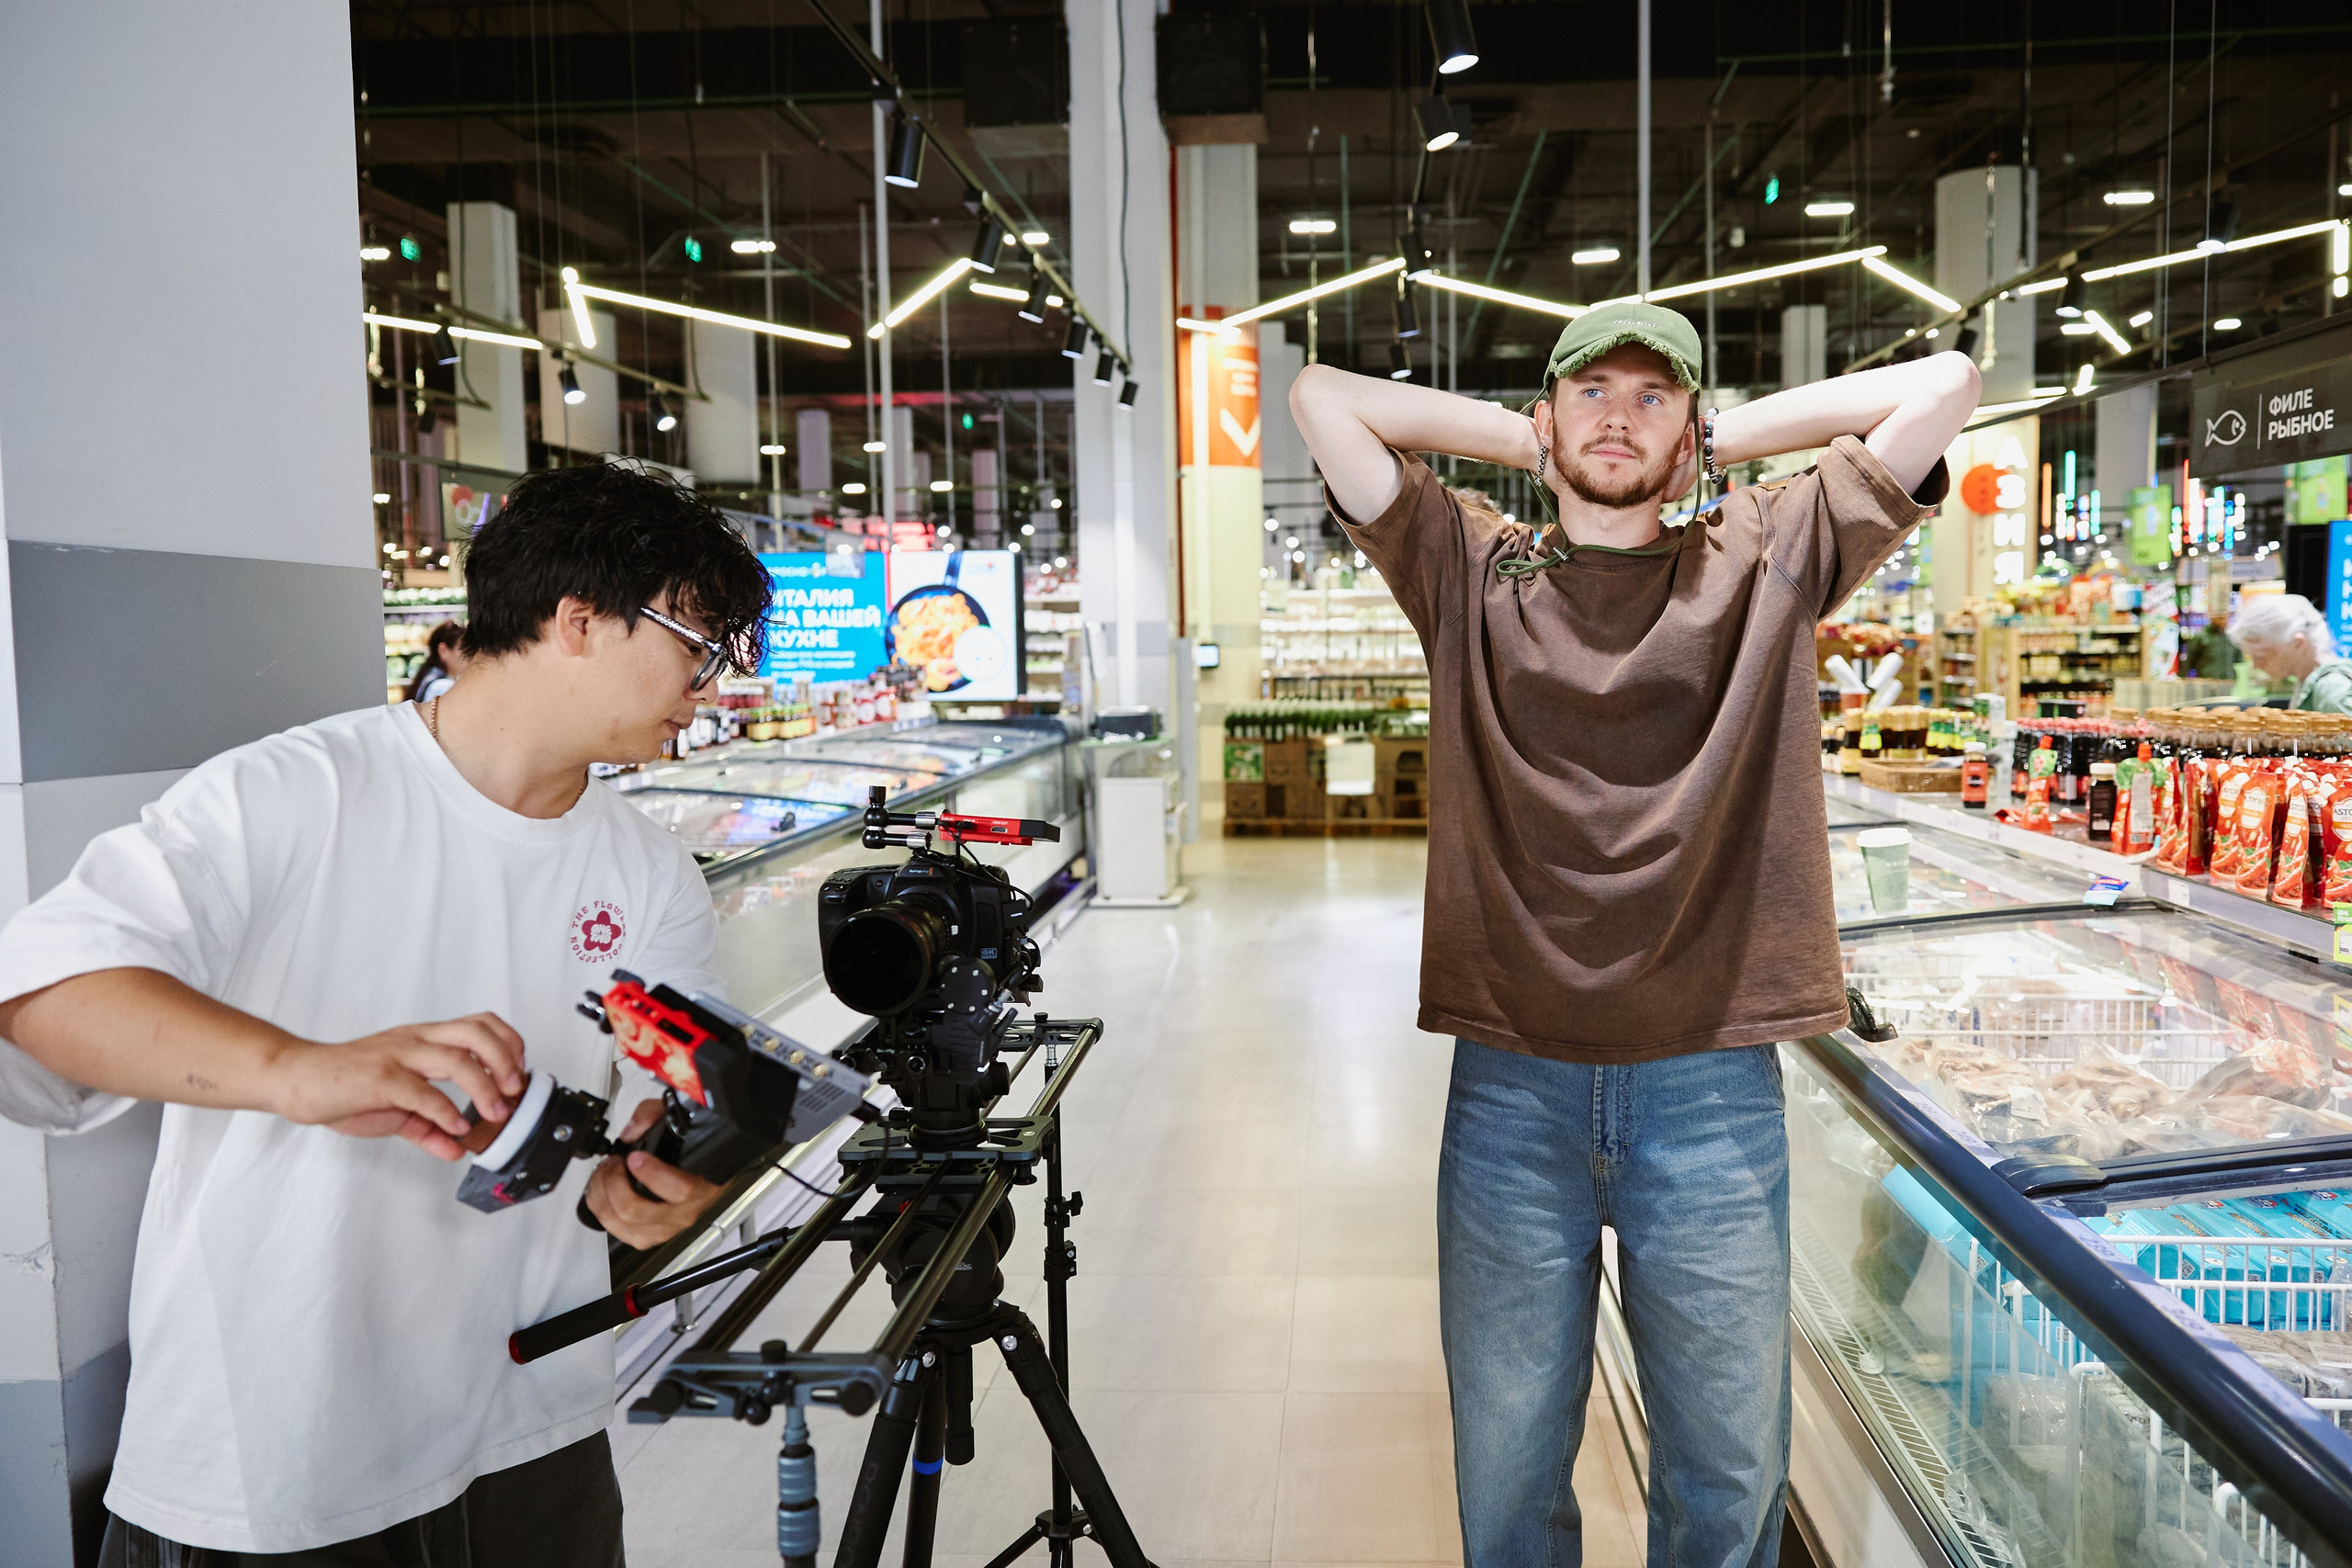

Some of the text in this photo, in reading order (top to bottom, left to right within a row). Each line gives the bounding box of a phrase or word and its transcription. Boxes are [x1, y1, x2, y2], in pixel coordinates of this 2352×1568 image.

[2268, 388, 2313, 416] ФИЛЕ
[2267, 409, 2335, 441] РЫБНОЕ
[1993, 436, 2029, 585] АЗИЯ
[802, 604, 881, 627] ВАШЕЙ
[769, 628, 839, 648] КУХНЕ
[571, 906, 588, 929] THE
[571, 936, 622, 963] COLLECTION
